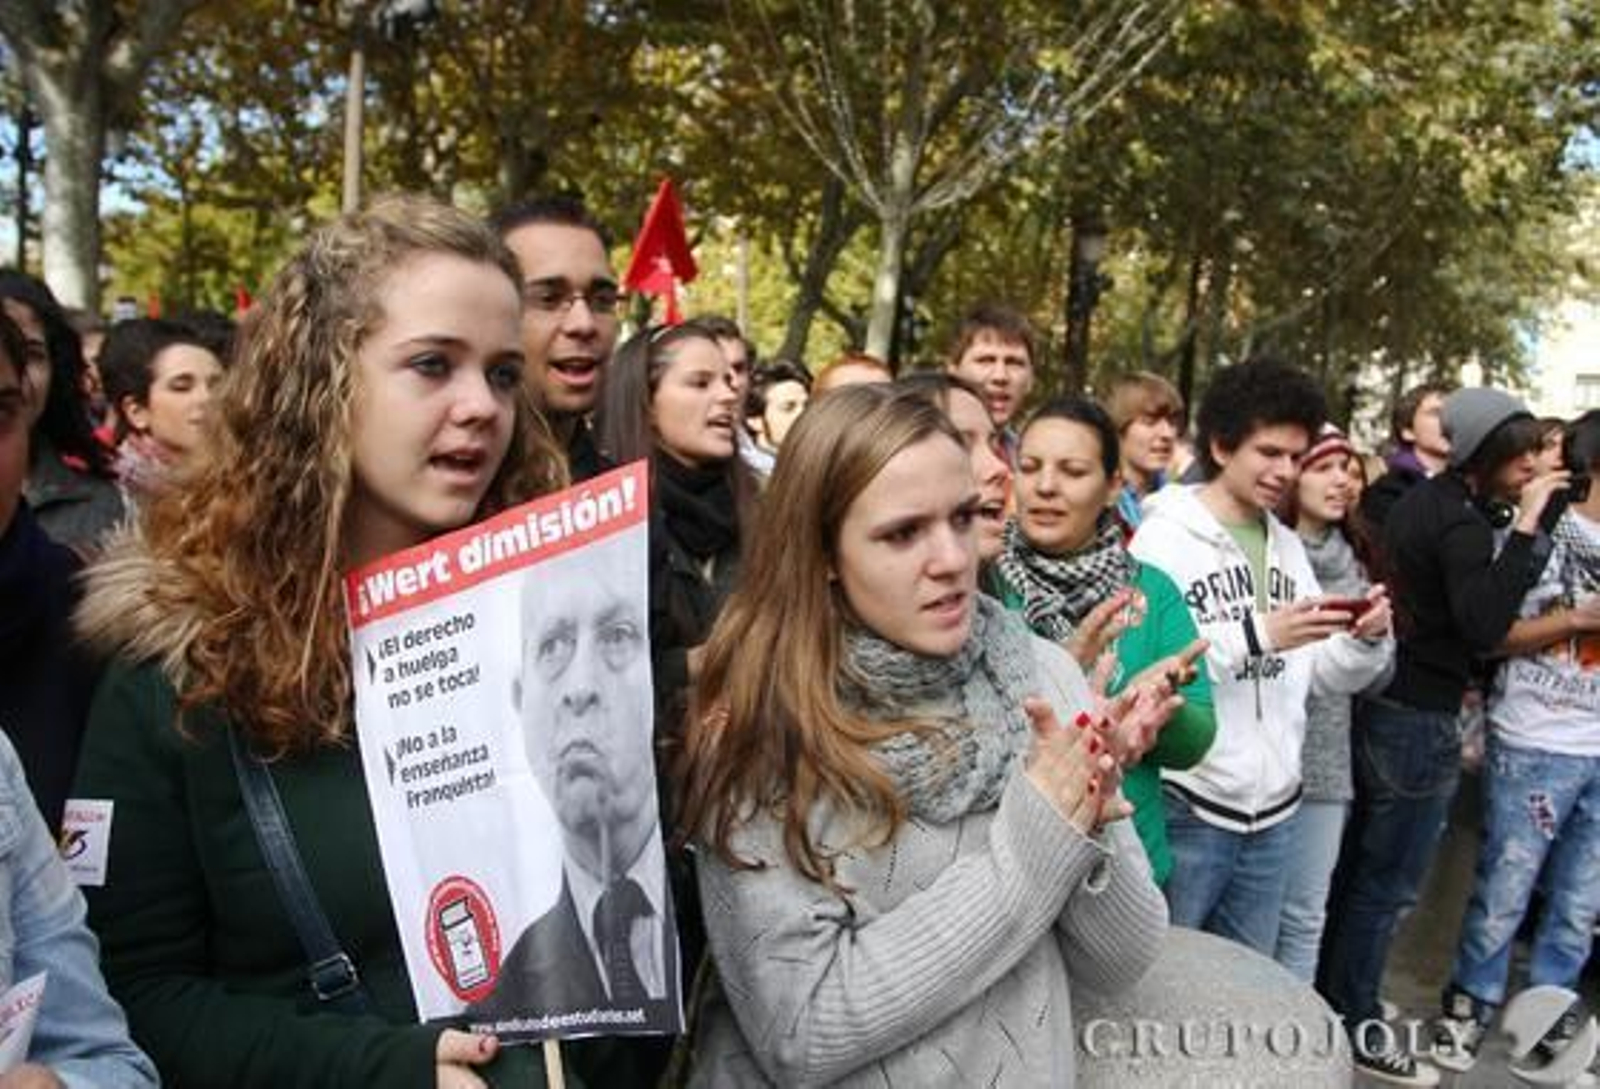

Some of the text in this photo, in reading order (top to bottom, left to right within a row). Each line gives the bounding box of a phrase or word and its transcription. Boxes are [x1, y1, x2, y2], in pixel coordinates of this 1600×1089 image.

[458, 474, 637, 574] dimisión!
[404, 613, 475, 647] derecho
[384, 647, 459, 684] a huelga
[387, 663, 481, 709] no se toca!
[427, 732, 439, 747] a
[441, 725, 458, 745] la
